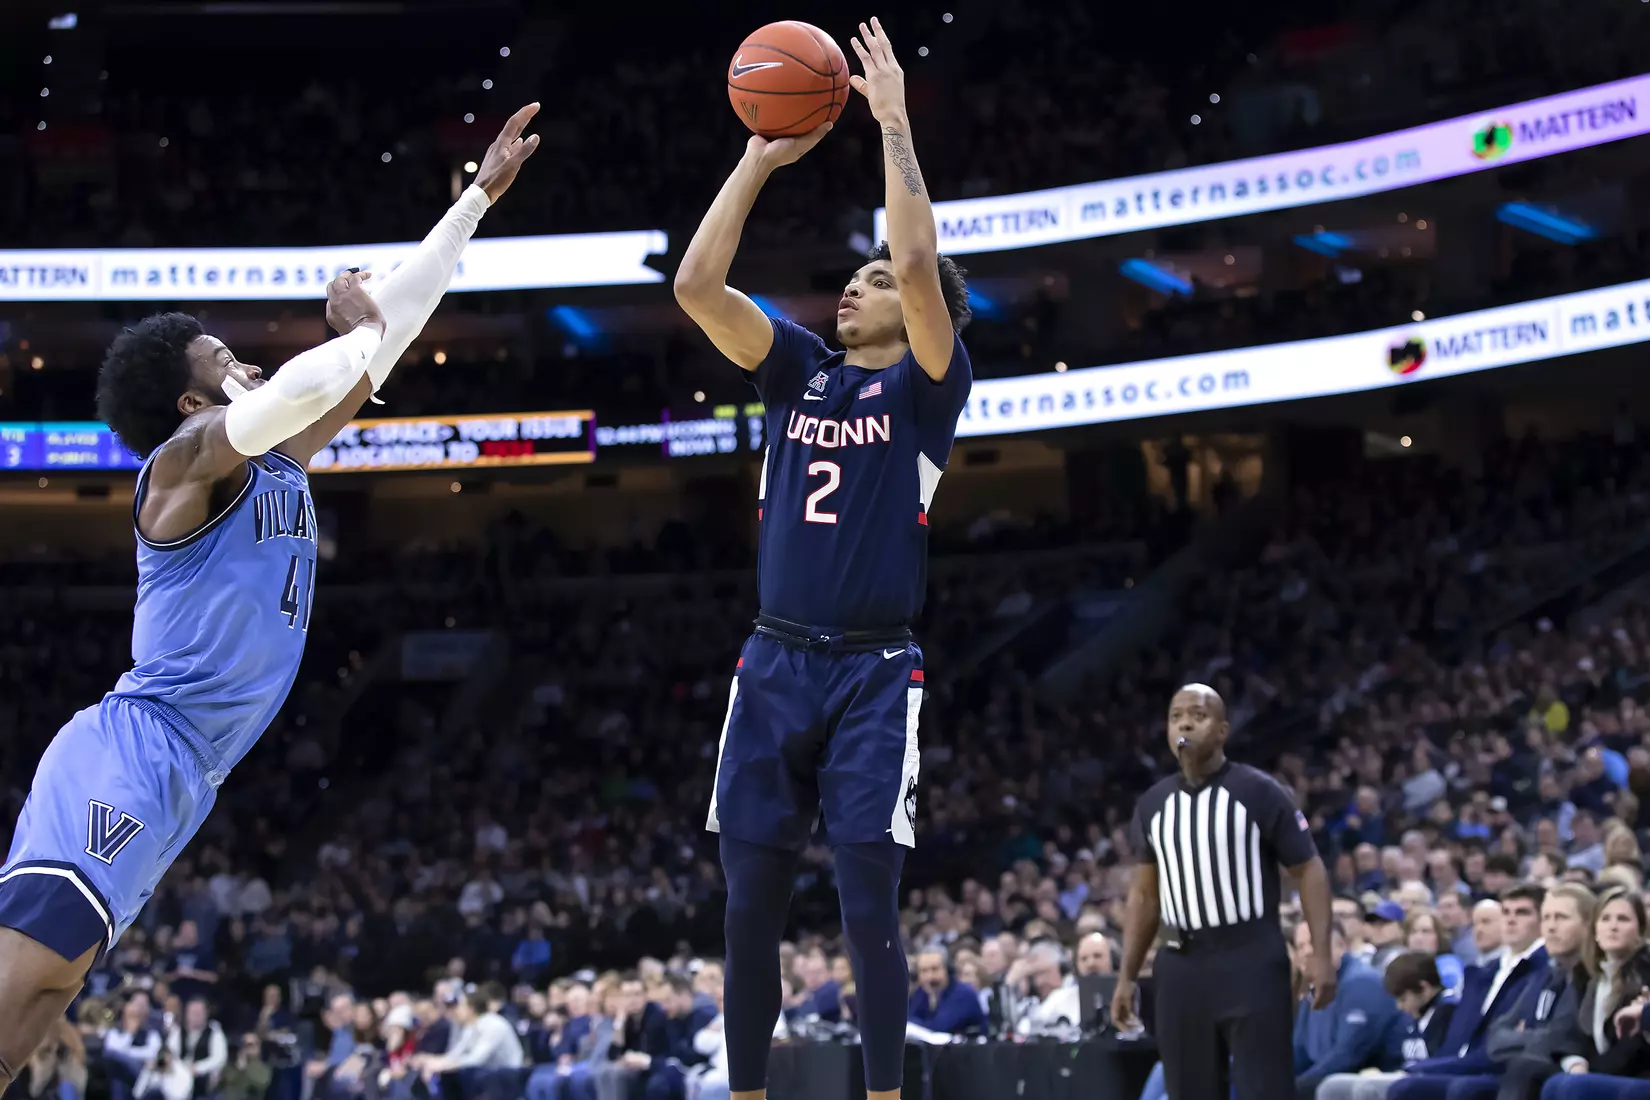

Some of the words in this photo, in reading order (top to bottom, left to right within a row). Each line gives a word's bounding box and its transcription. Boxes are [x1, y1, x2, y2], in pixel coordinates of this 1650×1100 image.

[1518, 96, 1638, 145] MATTERN
[940, 208, 1058, 238] MATTERN
[1080, 148, 1422, 221] matternassoc.com
[1432, 320, 1548, 360] MATTERN
[456, 418, 519, 443] YOUR
[520, 415, 582, 440] ISSUE
[787, 409, 891, 449] UCONN
[337, 442, 444, 467] LOCATION
[446, 440, 479, 463] TO
[804, 460, 842, 525] 2
[84, 798, 146, 867] V
